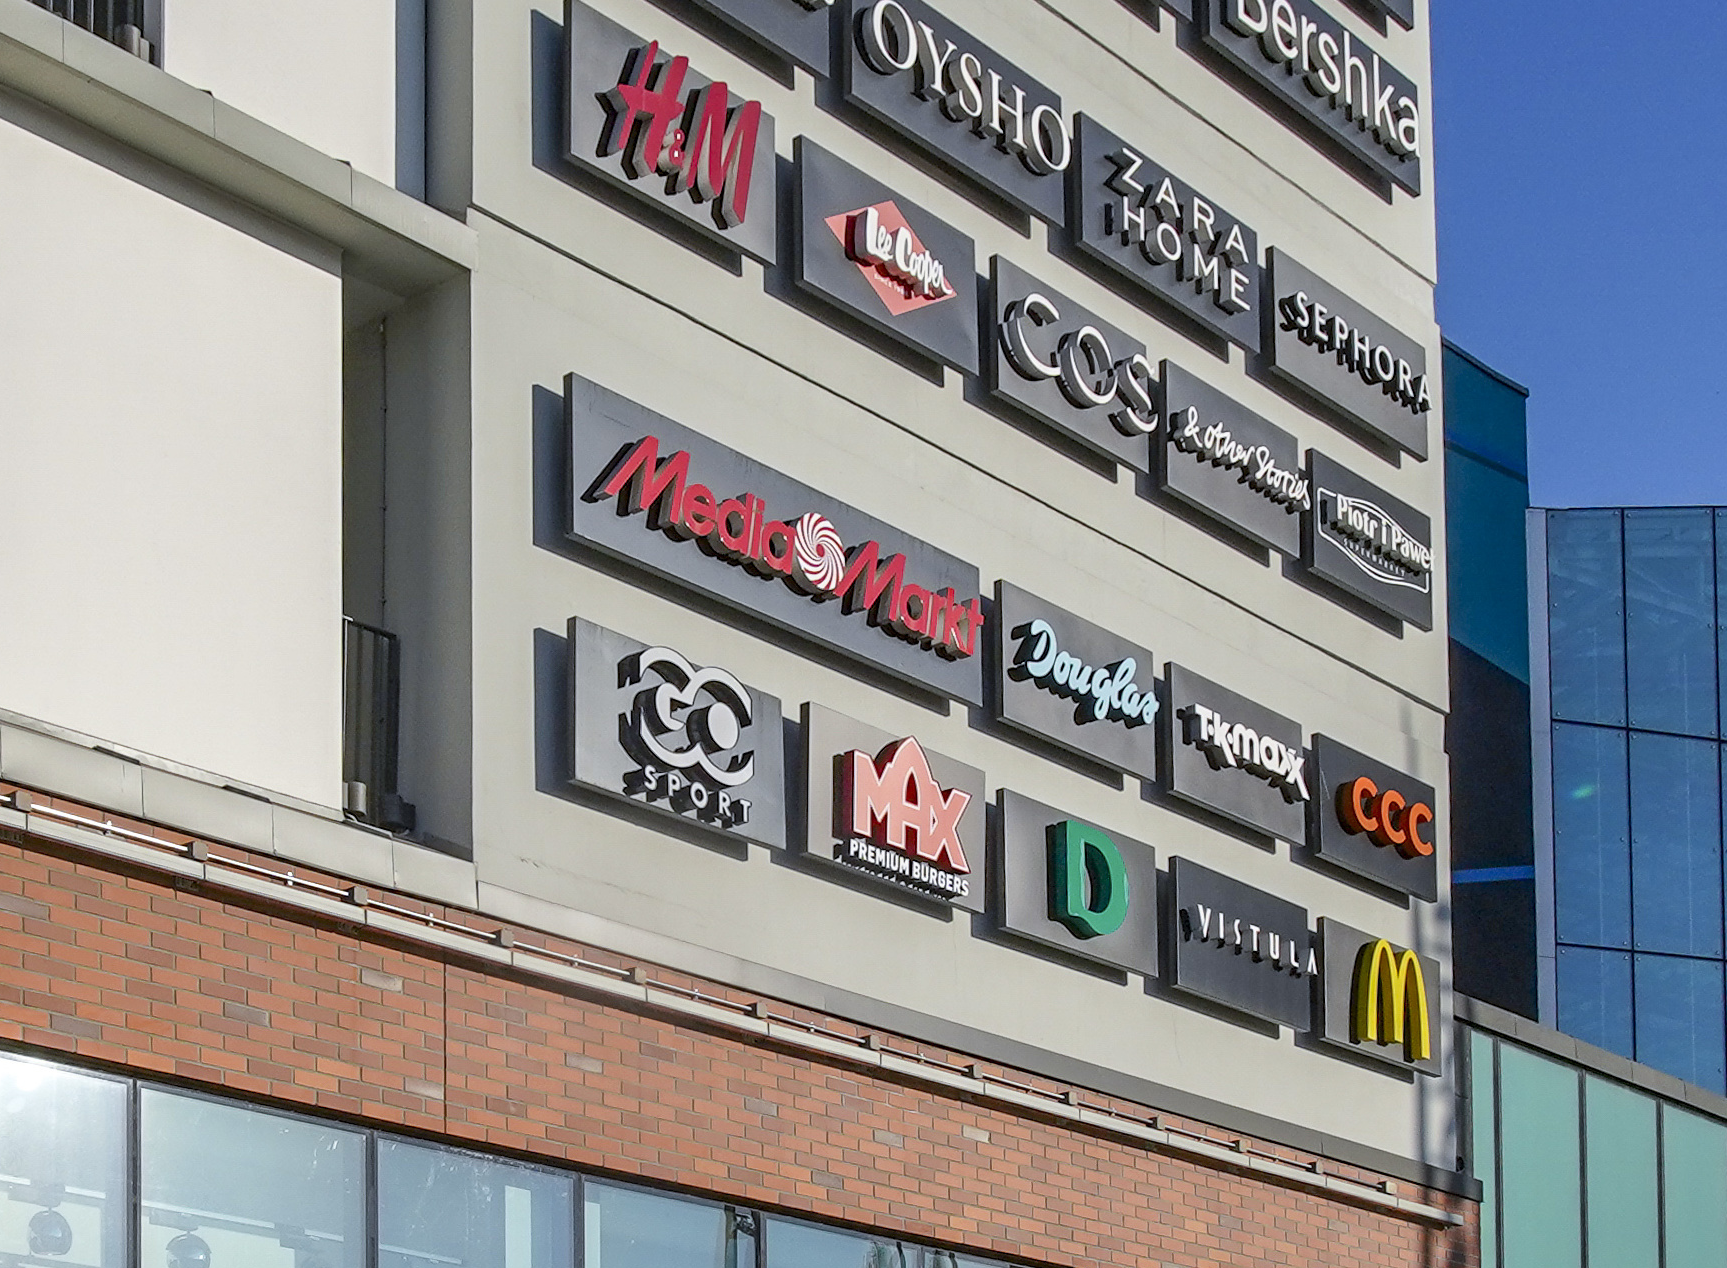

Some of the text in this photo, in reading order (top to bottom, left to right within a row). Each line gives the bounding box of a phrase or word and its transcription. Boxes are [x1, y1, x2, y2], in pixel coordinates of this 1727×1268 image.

[617, 40, 761, 223] H&M
[873, 0, 1072, 172] OYSHO
[866, 207, 893, 262] Lee
[895, 226, 953, 294] Cooper
[1122, 148, 1249, 264] ZARA
[1123, 196, 1251, 311] HOME
[1017, 293, 1158, 432] COS
[1296, 290, 1432, 409] SEPHORA
[1184, 406, 1203, 447] &
[1204, 422, 1252, 465] other
[1337, 494, 1378, 538] Piotr
[1380, 521, 1388, 545] i
[1027, 618, 1159, 724] Douglas
[643, 765, 752, 823] SPORT
[853, 736, 973, 874] MAX
[1352, 776, 1434, 858] CCC
[849, 838, 970, 898] PREMIUM BURGERS
[1197, 904, 1319, 975] VISTULA
